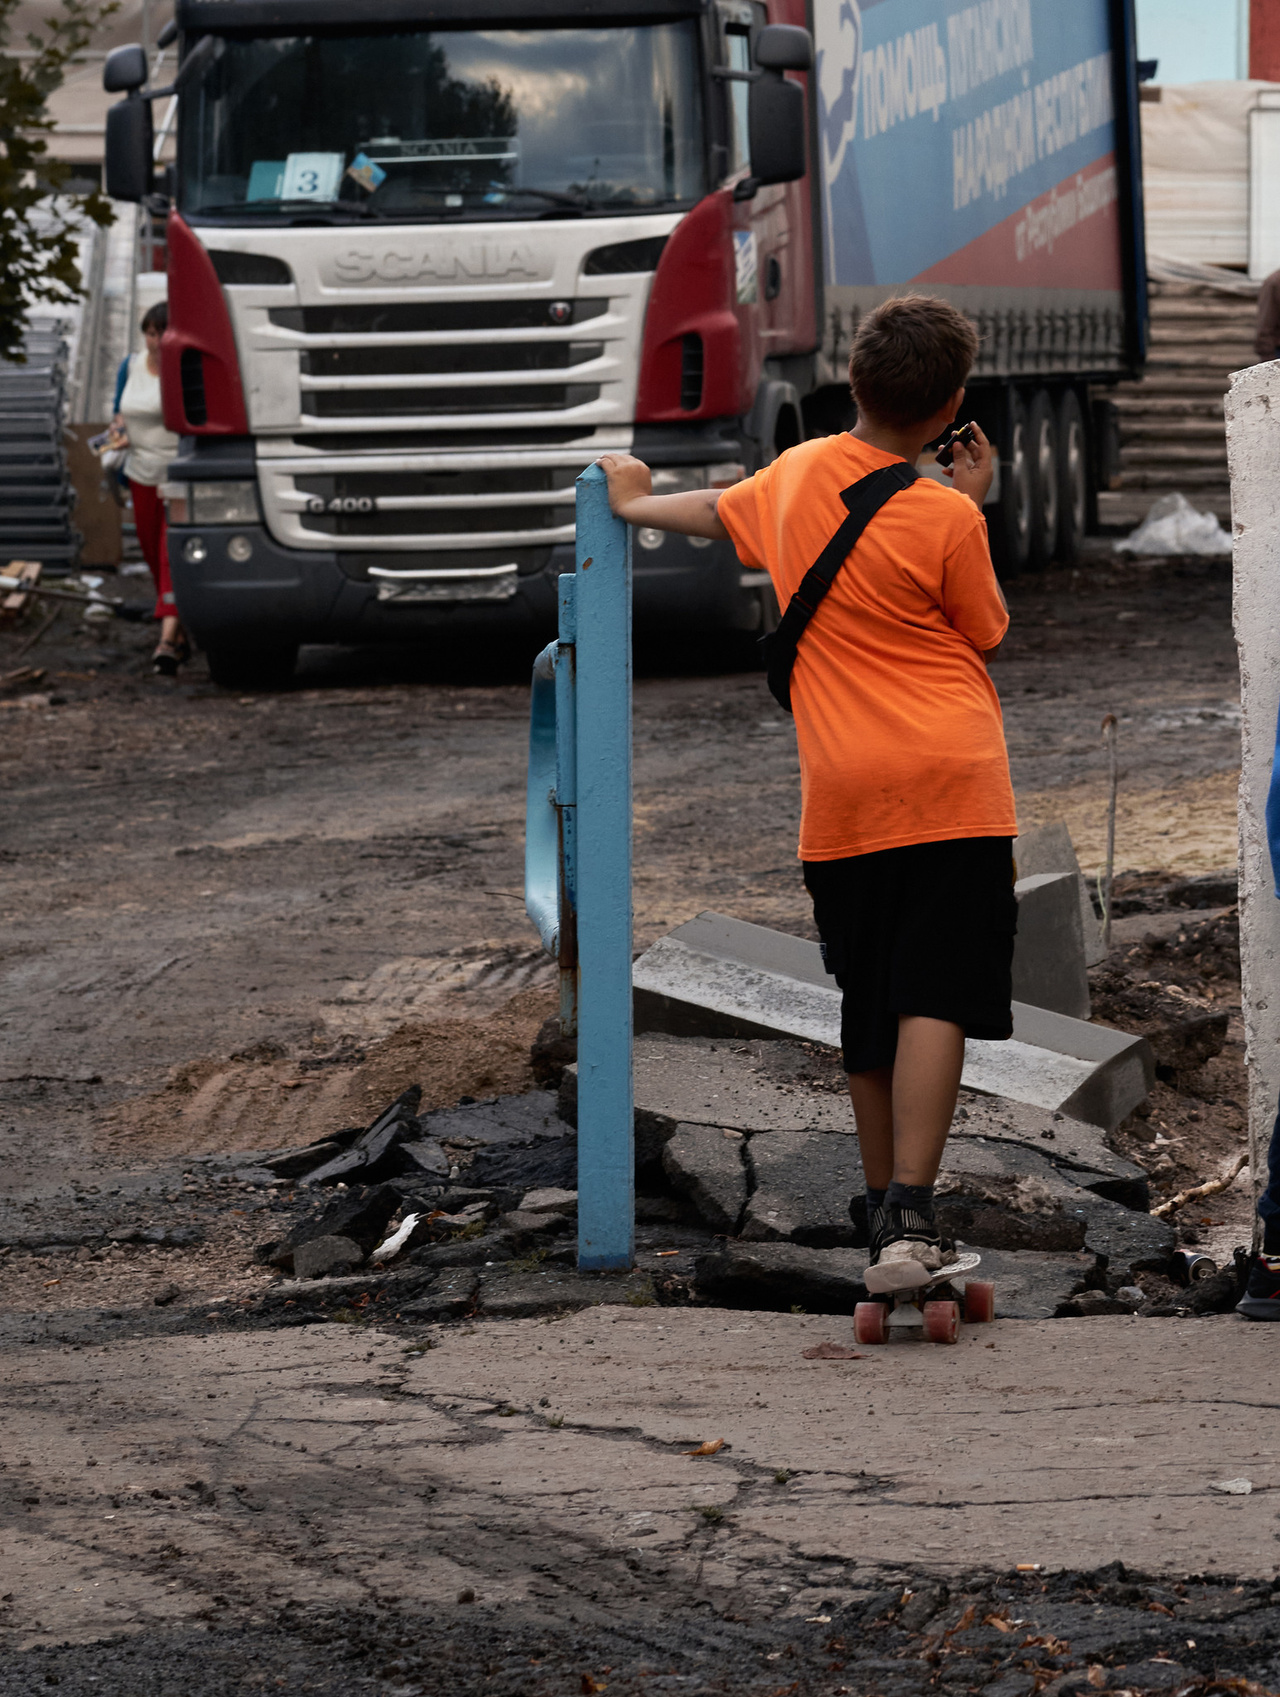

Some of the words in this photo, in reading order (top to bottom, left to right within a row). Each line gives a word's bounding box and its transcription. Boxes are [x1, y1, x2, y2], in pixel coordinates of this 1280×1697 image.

[862, 21, 948, 141] ПОМОЩЬ
[297, 170, 319, 194] 3
[334, 245, 539, 283] SCANIA
[328, 496, 373, 512] 400
